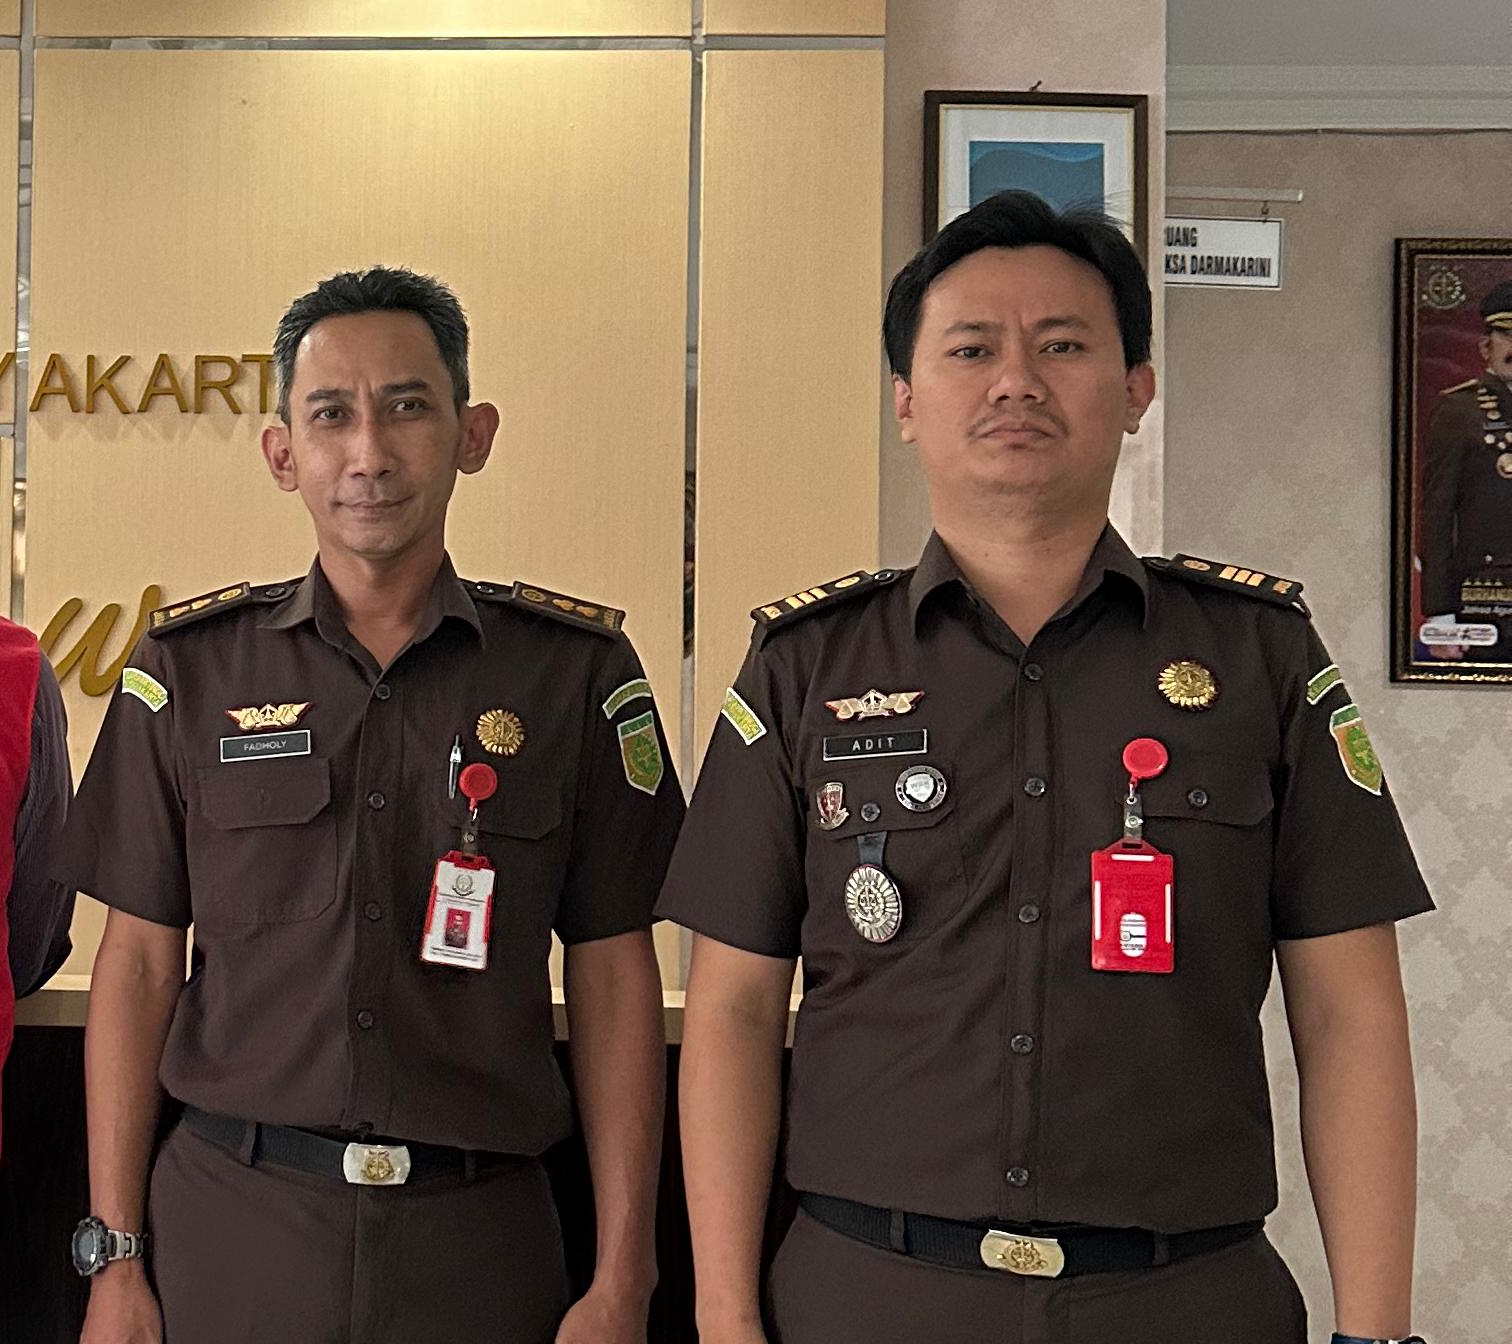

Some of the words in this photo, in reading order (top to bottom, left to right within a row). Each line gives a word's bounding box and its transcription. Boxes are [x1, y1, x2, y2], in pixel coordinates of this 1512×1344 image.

[1164, 225, 1198, 247] UANG
[1190, 255, 1272, 278] DARMAKARINI
[243, 739, 287, 752] FADHOLY
[852, 737, 896, 752] ADIT
